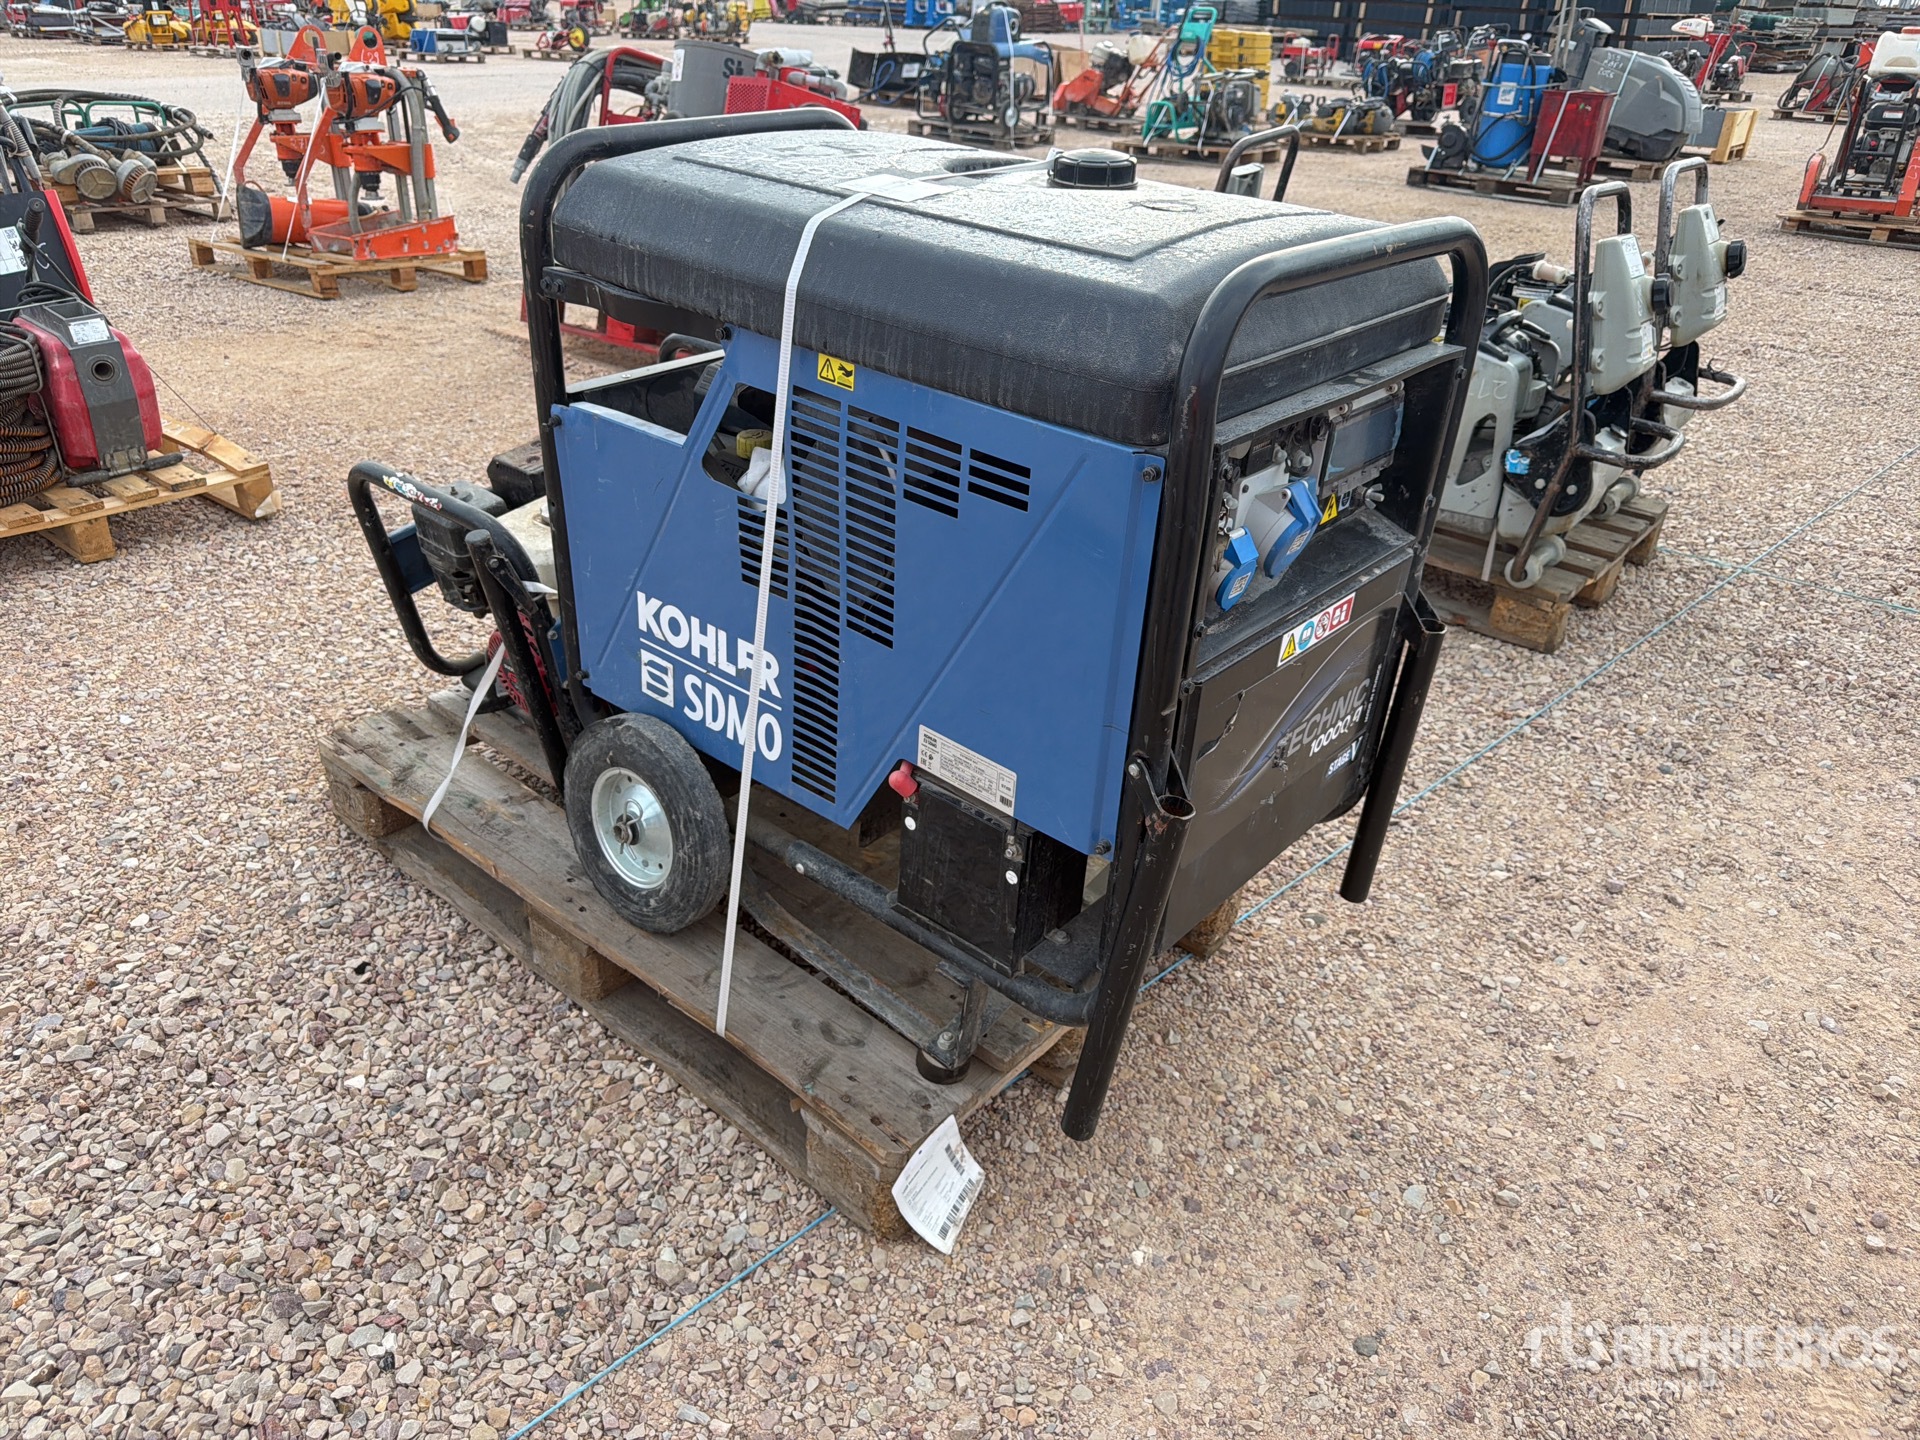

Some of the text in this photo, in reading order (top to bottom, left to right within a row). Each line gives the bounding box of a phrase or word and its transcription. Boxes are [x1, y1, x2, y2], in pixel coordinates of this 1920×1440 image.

[637, 590, 783, 699] KOHLER
[682, 672, 783, 762] SDMO
[1327, 748, 1351, 775] STAGE
[1350, 735, 1364, 762] V
